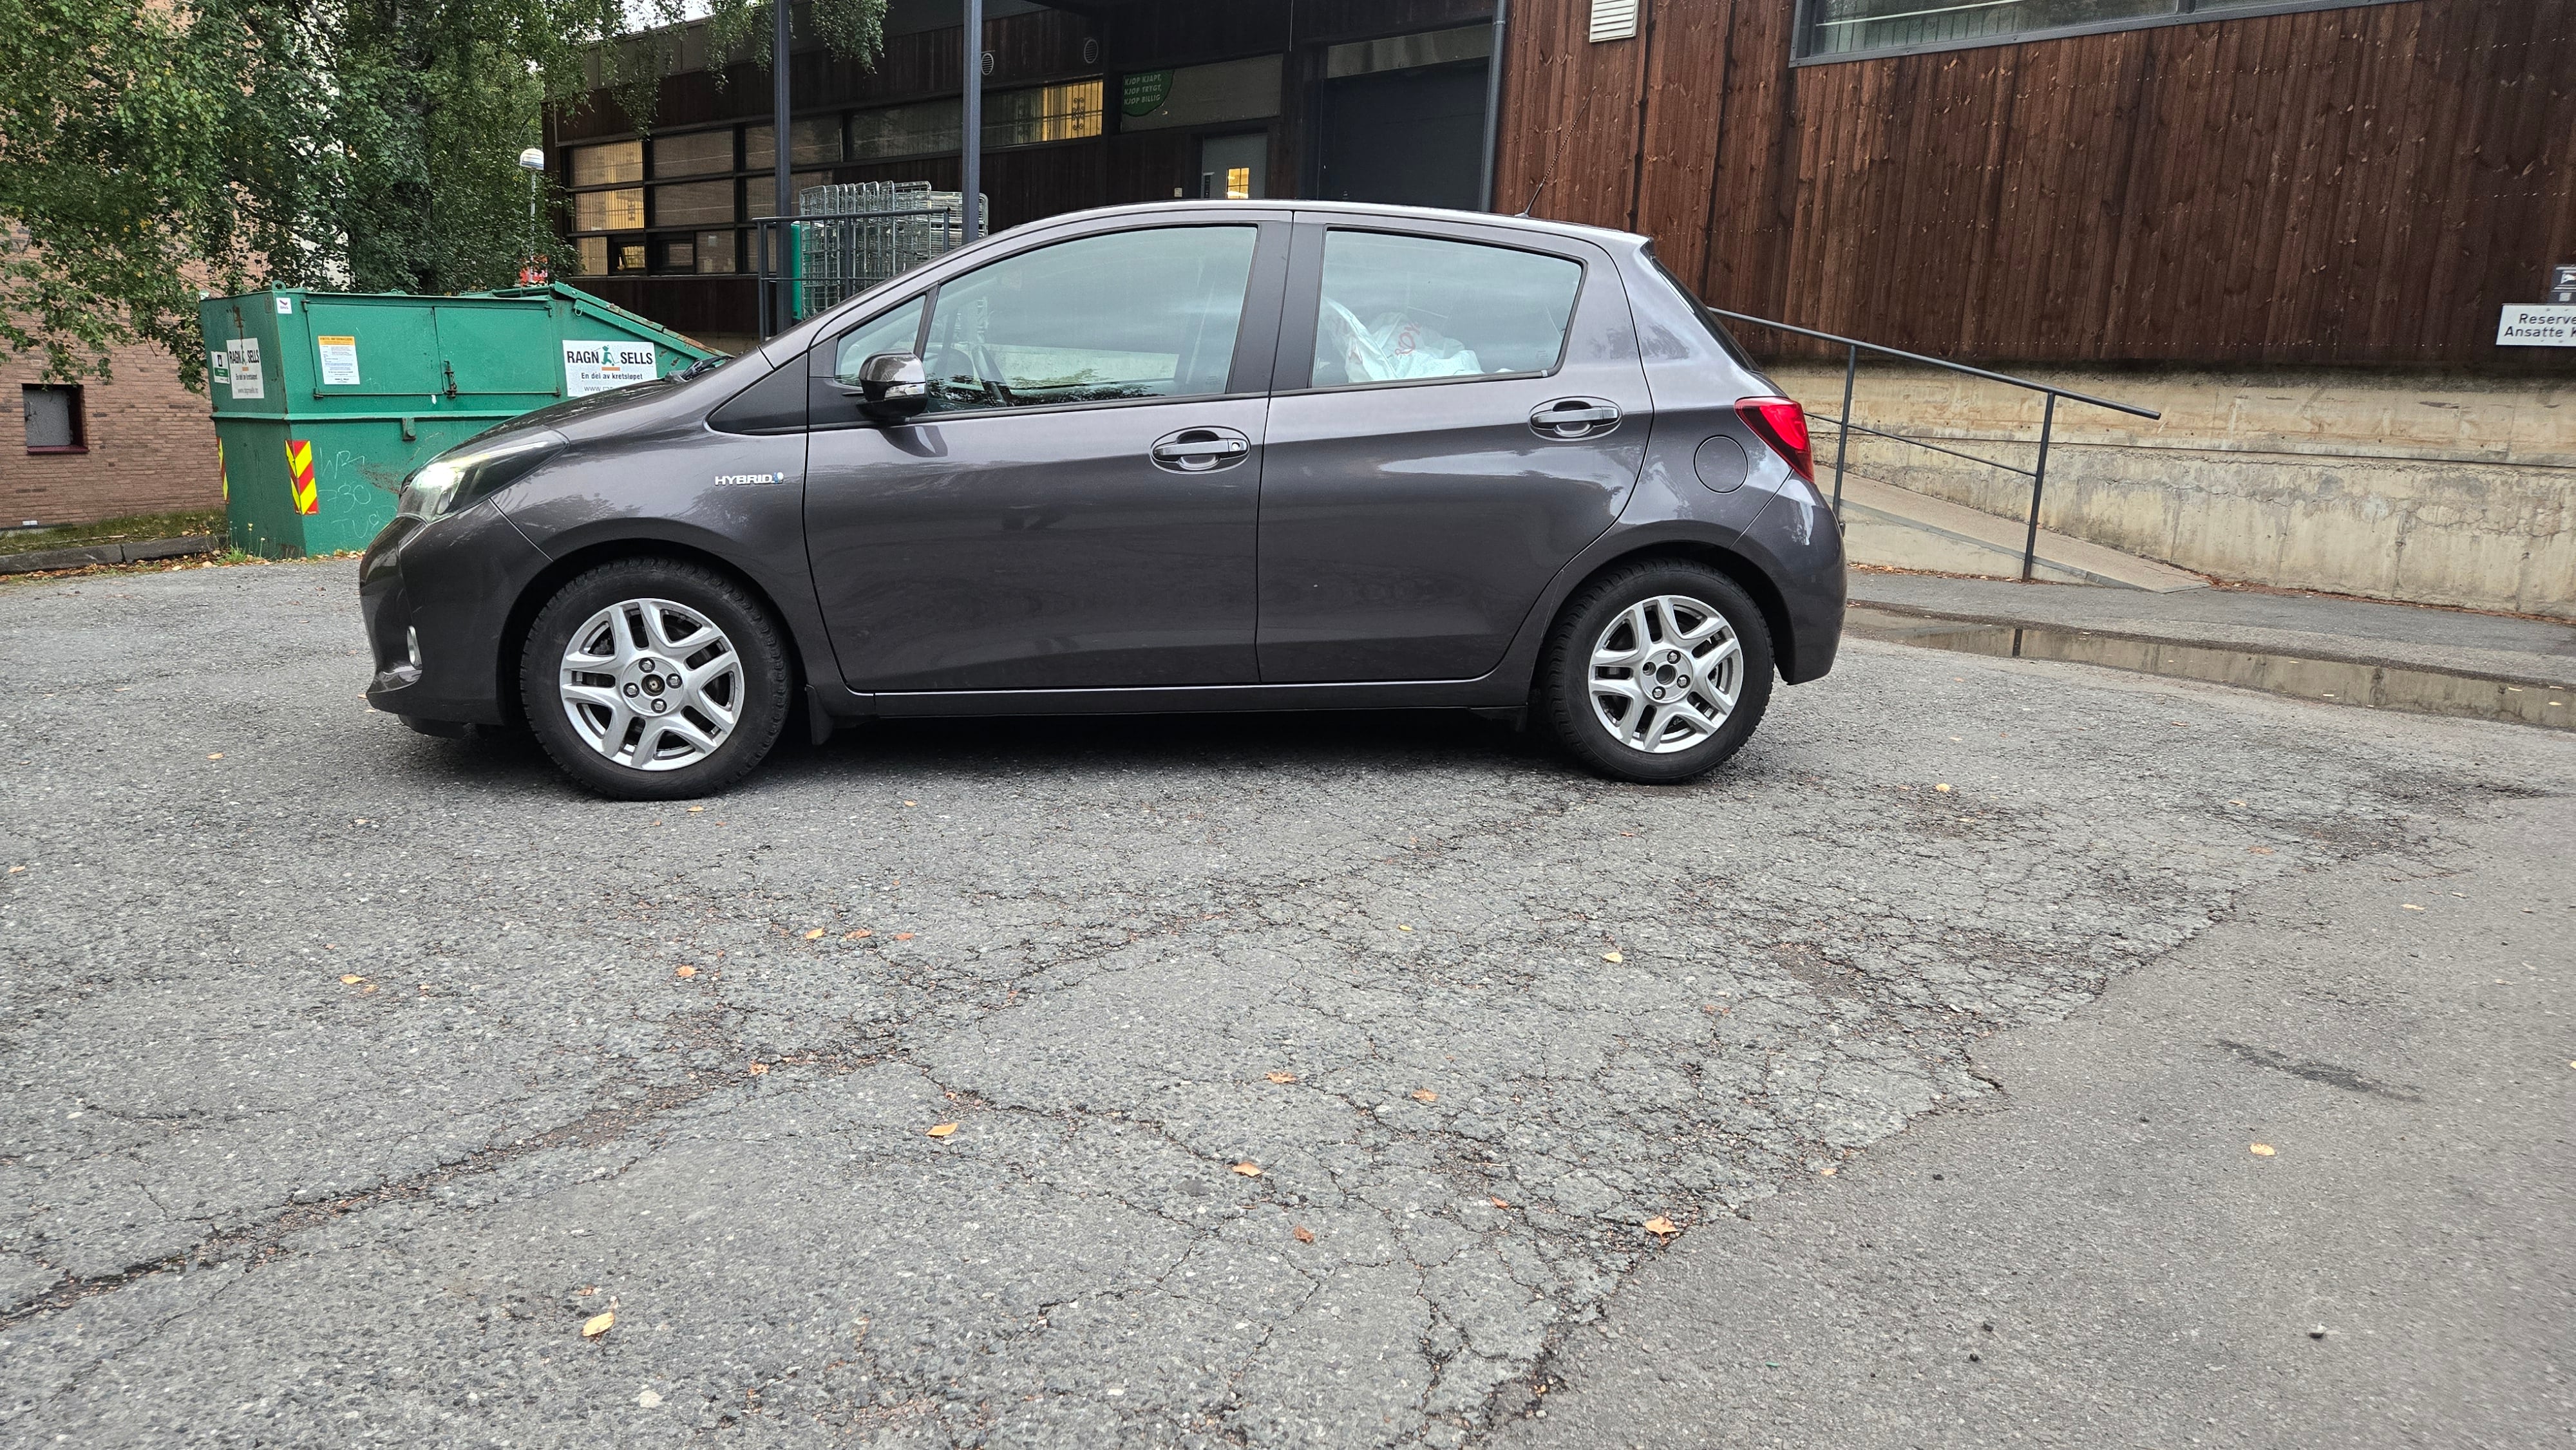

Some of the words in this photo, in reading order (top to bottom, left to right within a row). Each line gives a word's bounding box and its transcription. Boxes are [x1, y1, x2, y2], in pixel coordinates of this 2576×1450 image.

[1142, 84, 1161, 93] TRYGT,
[2504, 326, 2564, 337] Ansatte
[247, 350, 260, 364] SELLS
[567, 351, 600, 364] RAGN
[620, 352, 653, 364] SELLS
[715, 475, 773, 486] HYBRID
